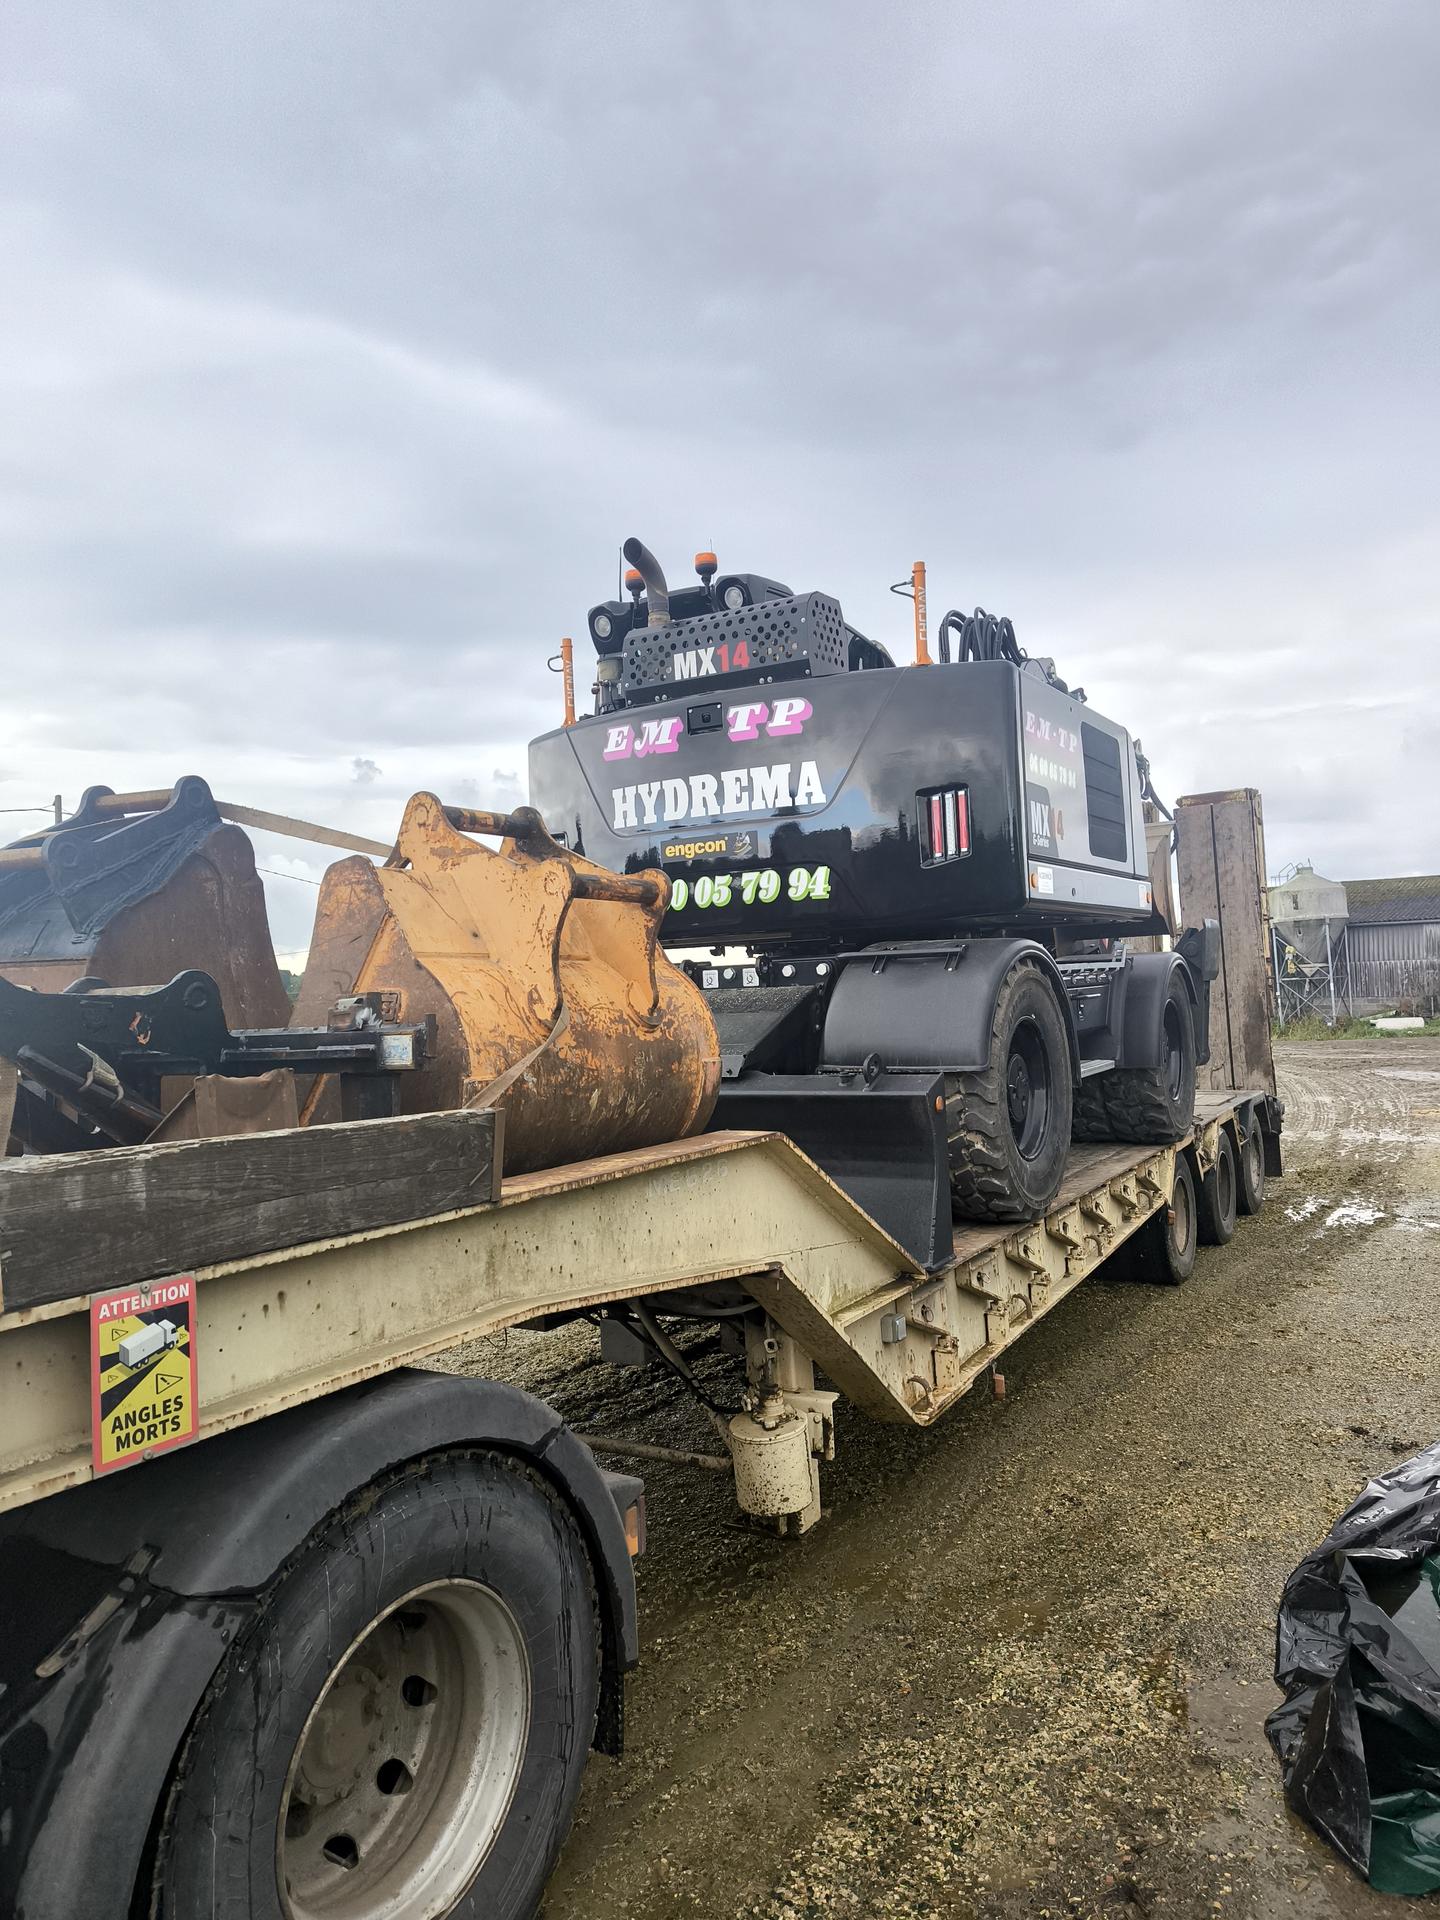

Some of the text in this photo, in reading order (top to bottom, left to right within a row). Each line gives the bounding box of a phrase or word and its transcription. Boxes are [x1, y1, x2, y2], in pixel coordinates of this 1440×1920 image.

[673, 640, 750, 681] MX14
[603, 697, 812, 762] EM TP
[612, 760, 827, 829] HYDREMA
[665, 839, 726, 859] engcon
[694, 873, 732, 909] 05
[741, 869, 780, 905] 79
[788, 865, 831, 902] 94
[98, 1282, 190, 1320] ATTENTION
[111, 1395, 184, 1435] ANGLES
[115, 1414, 181, 1453] MORTS
